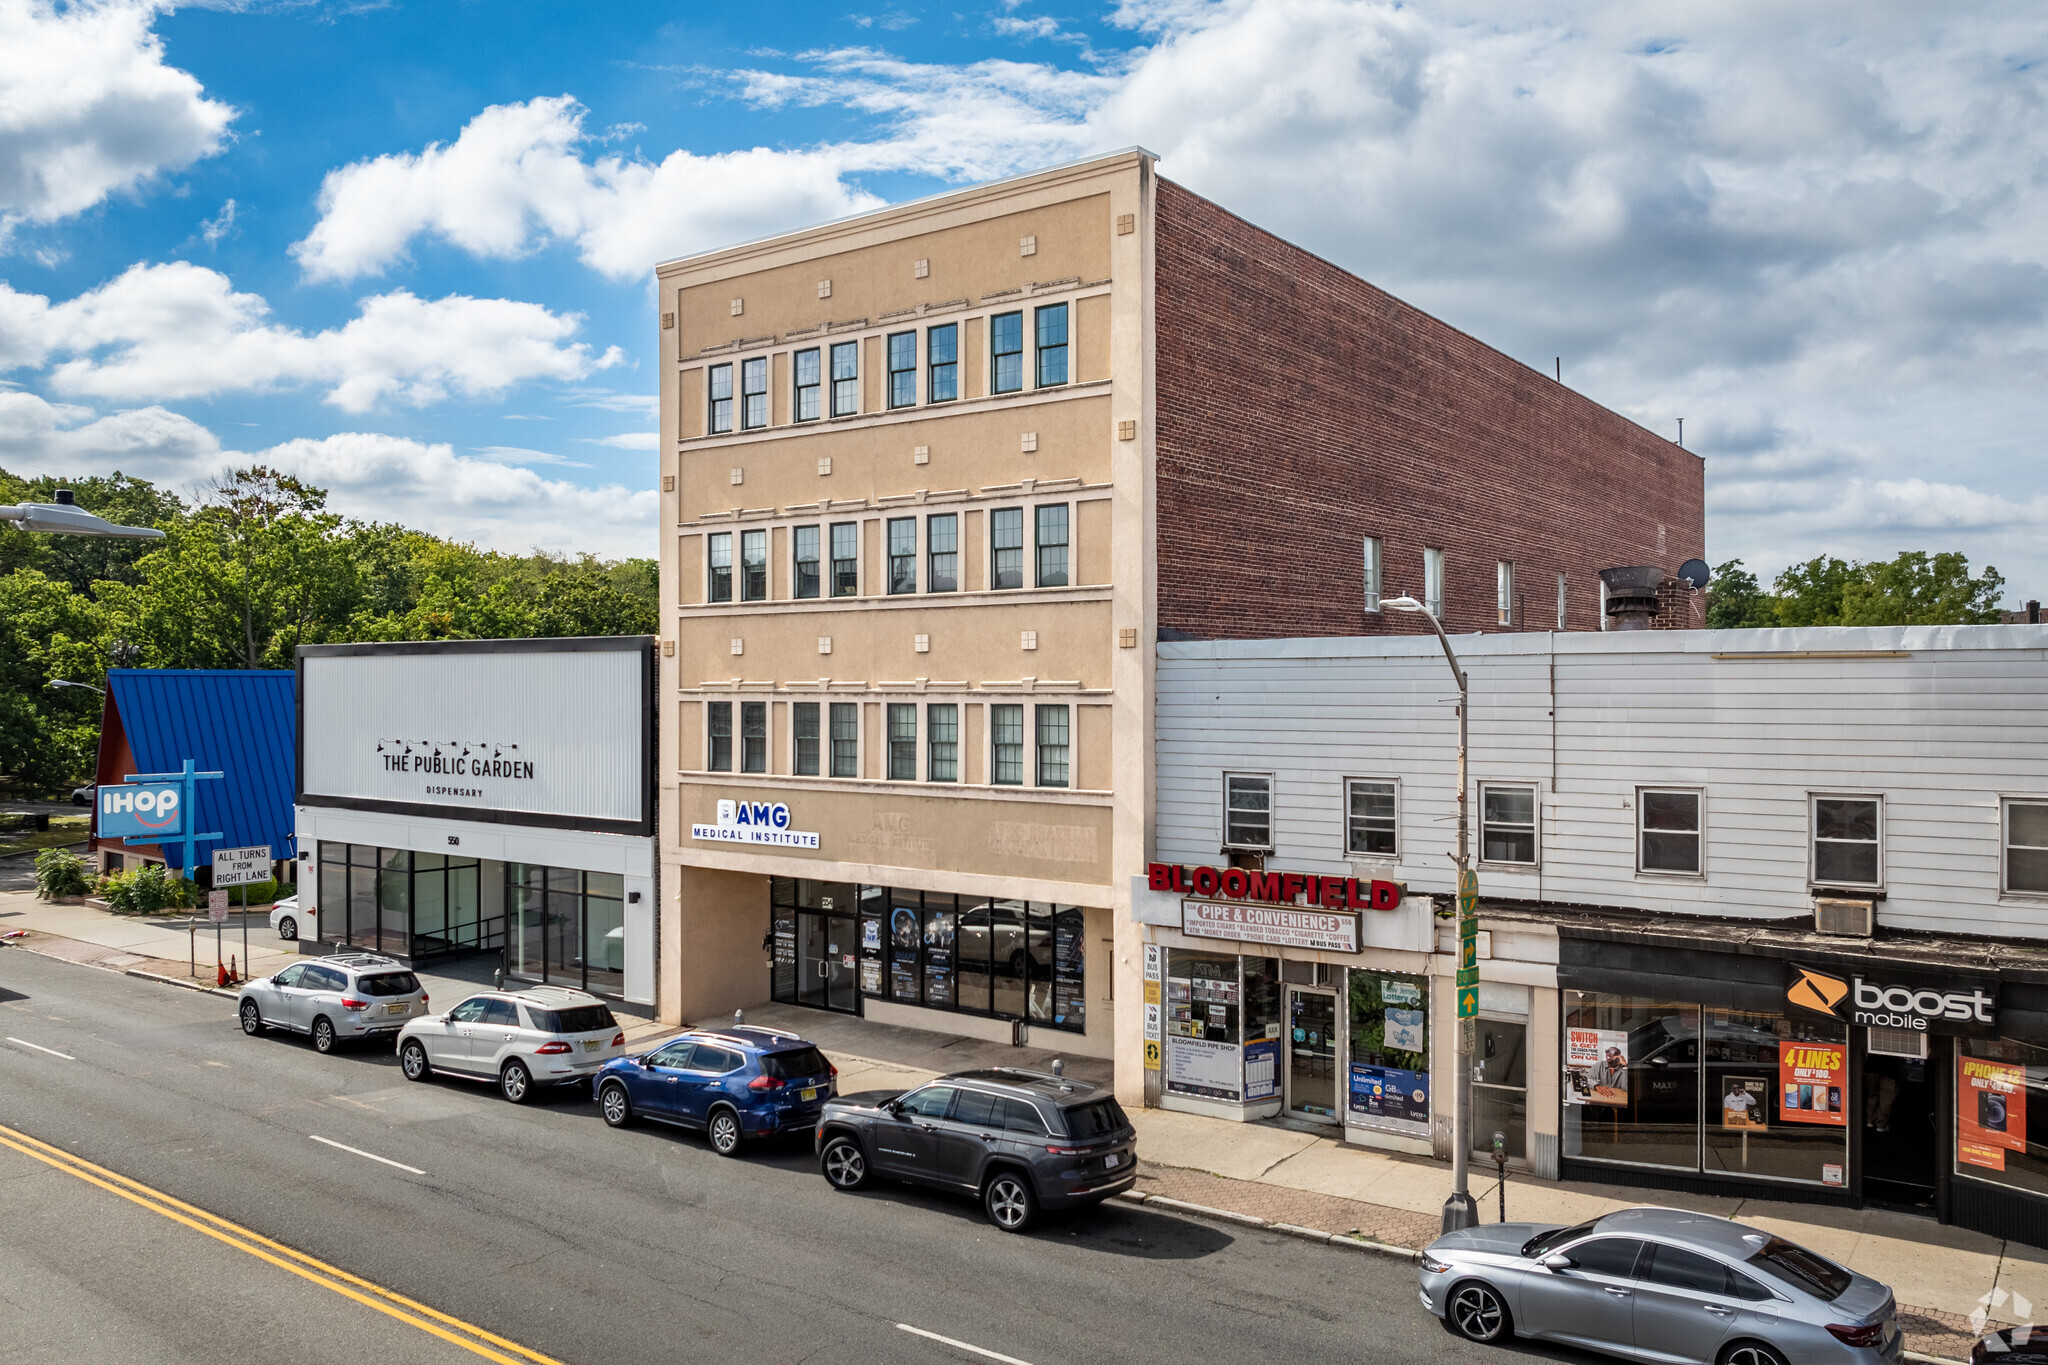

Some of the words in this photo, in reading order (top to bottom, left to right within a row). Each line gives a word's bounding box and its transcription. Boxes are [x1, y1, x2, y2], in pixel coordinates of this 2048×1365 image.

[383, 755, 409, 772] THE
[414, 756, 466, 775] PUBLIC
[471, 759, 534, 779] GARDEN
[426, 786, 483, 797] DISPENSARY
[104, 790, 178, 818] IHOP
[737, 804, 788, 828] AMG
[448, 836, 460, 846] 550
[693, 828, 743, 840] MEDICAL
[751, 831, 817, 845] INSTITUTE
[218, 852, 234, 862] ALL
[239, 849, 267, 860] TURNS
[232, 862, 252, 870] FROM
[216, 873, 241, 884] RIGHT
[246, 870, 268, 881] LANE
[1148, 862, 1401, 912] BLOOMFIELD
[1202, 905, 1230, 921] PIPE
[1234, 908, 1243, 922] &
[1246, 909, 1336, 932] CONVENIENCE
[1316, 940, 1327, 948] BUS
[1328, 941, 1342, 949] PASS
[1193, 962, 1221, 977] ATM
[1383, 993, 1409, 1002] Lottery
[1400, 986, 1419, 997] Jersey
[1854, 978, 1992, 1022] boost
[1855, 1012, 1927, 1030] mobile
[1146, 1031, 1160, 1039] TICKET
[1571, 1031, 1598, 1044] SWITCH
[1172, 1038, 1207, 1048] BLOOMFIELD
[1208, 1042, 1220, 1050] PIPE
[1784, 1049, 1795, 1067] 4
[1797, 1050, 1841, 1070] LINES
[1794, 1068, 1812, 1077] ONLY
[1964, 1062, 2007, 1082] iPHONE
[2008, 1069, 2021, 1084] 12
[1353, 1075, 1382, 1086] Unlimited
[1652, 1081, 1673, 1090] MAX
[1971, 1077, 1989, 1088] ONLY
[1385, 1084, 1397, 1093] GB
